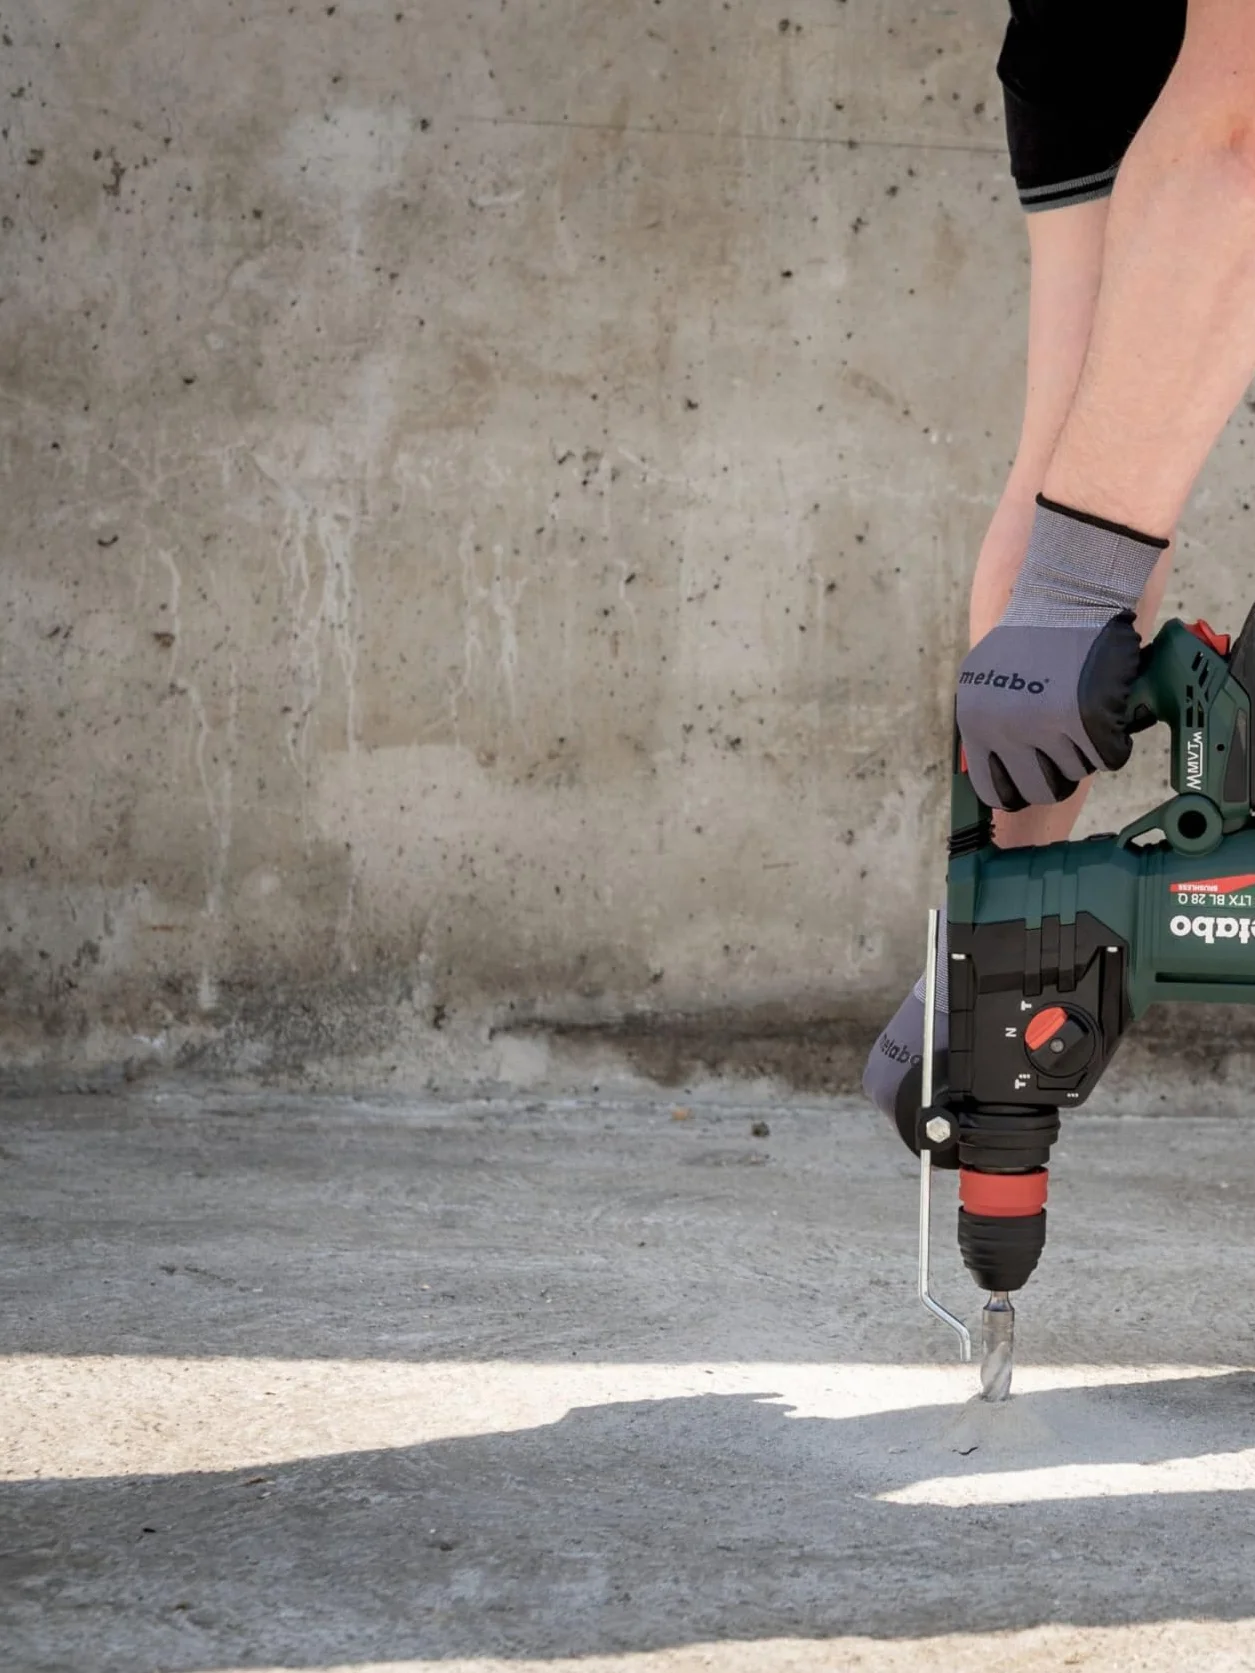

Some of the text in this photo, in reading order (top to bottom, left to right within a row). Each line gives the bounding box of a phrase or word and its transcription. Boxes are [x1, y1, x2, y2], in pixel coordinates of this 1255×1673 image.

[959, 670, 1045, 694] metabo
[1177, 893, 1188, 904] Q
[1191, 893, 1206, 904] 28
[1209, 894, 1225, 904] BL
[1229, 895, 1251, 906] LTX
